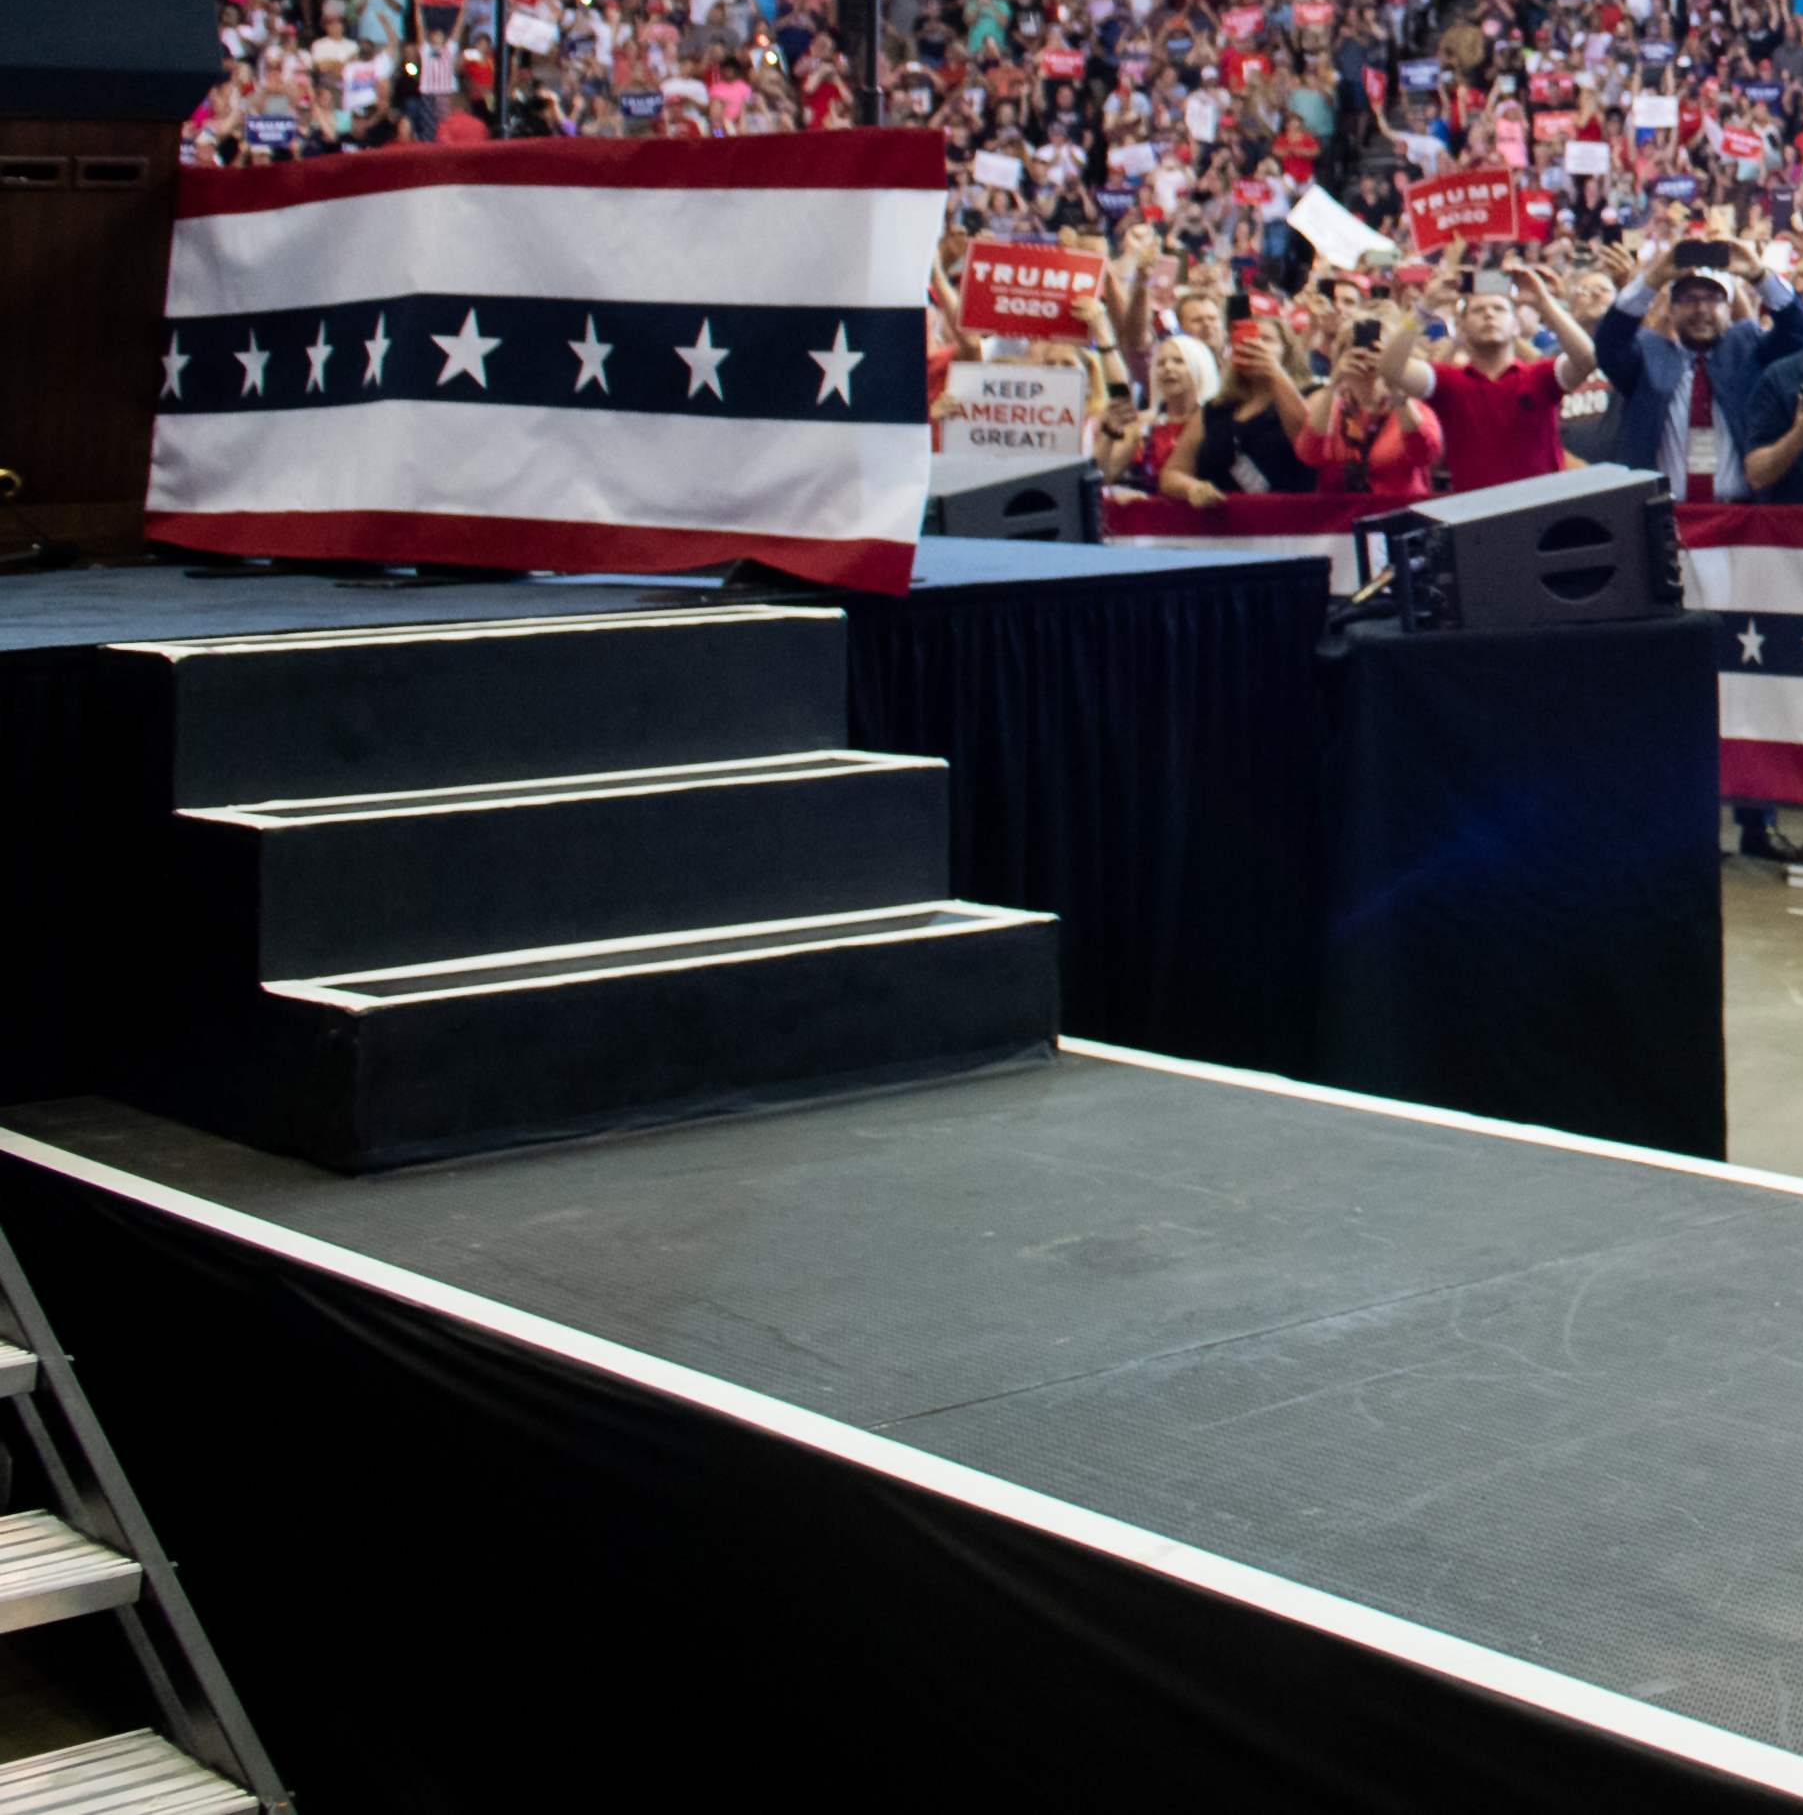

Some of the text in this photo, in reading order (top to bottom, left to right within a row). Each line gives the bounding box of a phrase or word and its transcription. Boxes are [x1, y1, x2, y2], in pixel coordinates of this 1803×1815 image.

[1412, 182, 1508, 215] TRUMP
[972, 260, 1096, 292] TRUMP
[994, 295, 1060, 319] 2020
[983, 378, 1044, 400] KEEP
[953, 402, 1075, 426] AMERICA
[1561, 388, 1609, 419] 2020
[970, 427, 1056, 449] GREAT!
